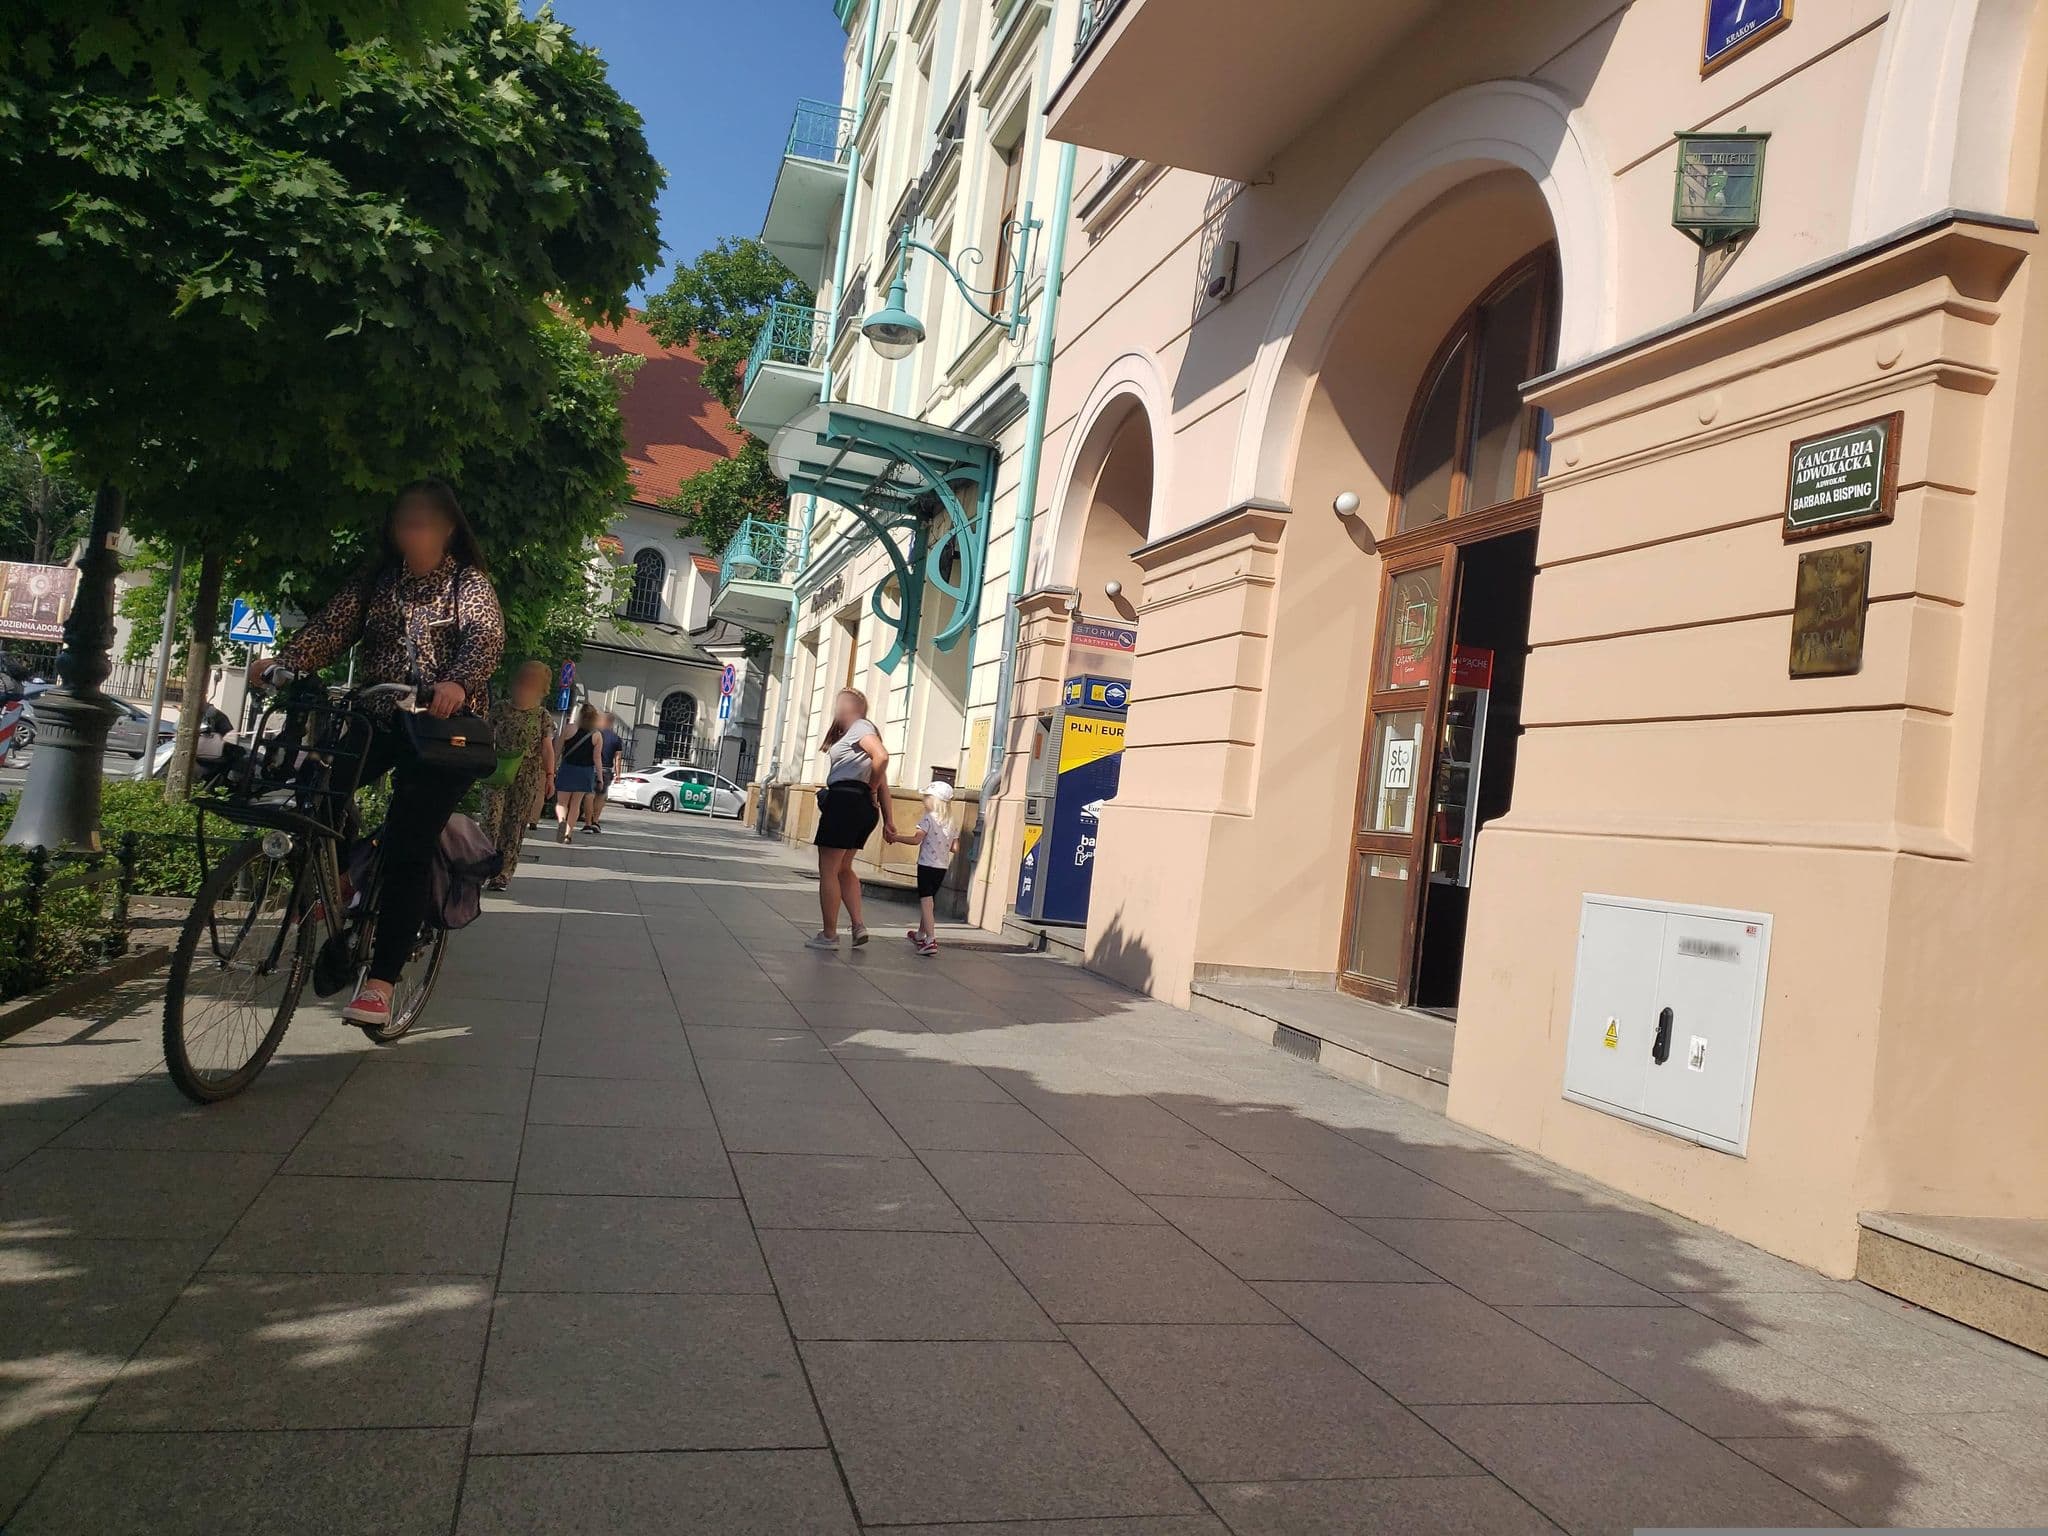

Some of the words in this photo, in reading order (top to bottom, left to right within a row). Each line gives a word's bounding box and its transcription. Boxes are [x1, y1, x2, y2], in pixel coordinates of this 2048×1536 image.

[1726, 20, 1756, 44] KRAKÓW
[1796, 454, 1872, 485] ADWOKACKA
[1815, 475, 1847, 488] ADWOKAT
[1793, 491, 1832, 511] BARBARA
[1833, 482, 1872, 502] BISPING
[1076, 625, 1115, 638] STORM
[1071, 722, 1092, 733] PLN
[1101, 726, 1125, 737] EUR
[685, 789, 707, 803] Bolt
[1081, 834, 1096, 847] ba
